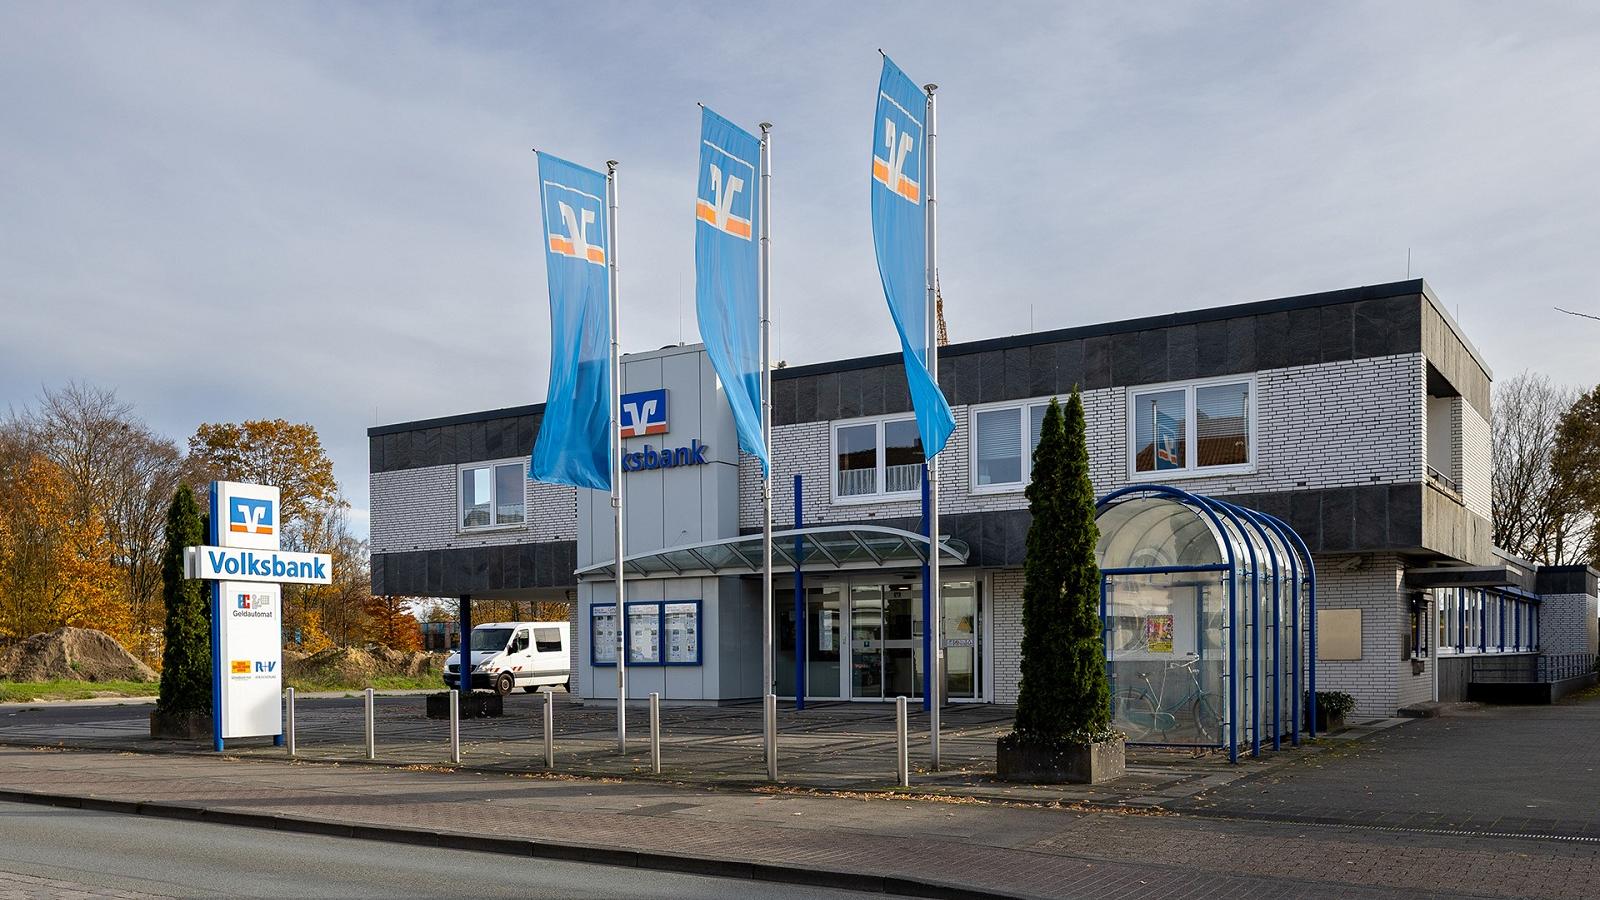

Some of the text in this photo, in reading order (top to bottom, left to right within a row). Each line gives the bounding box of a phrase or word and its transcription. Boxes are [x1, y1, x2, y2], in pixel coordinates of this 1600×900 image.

[620, 438, 708, 472] ksbank
[208, 551, 326, 579] Volksbank
[232, 610, 272, 618] Geldautomat
[255, 661, 276, 672] R+V
